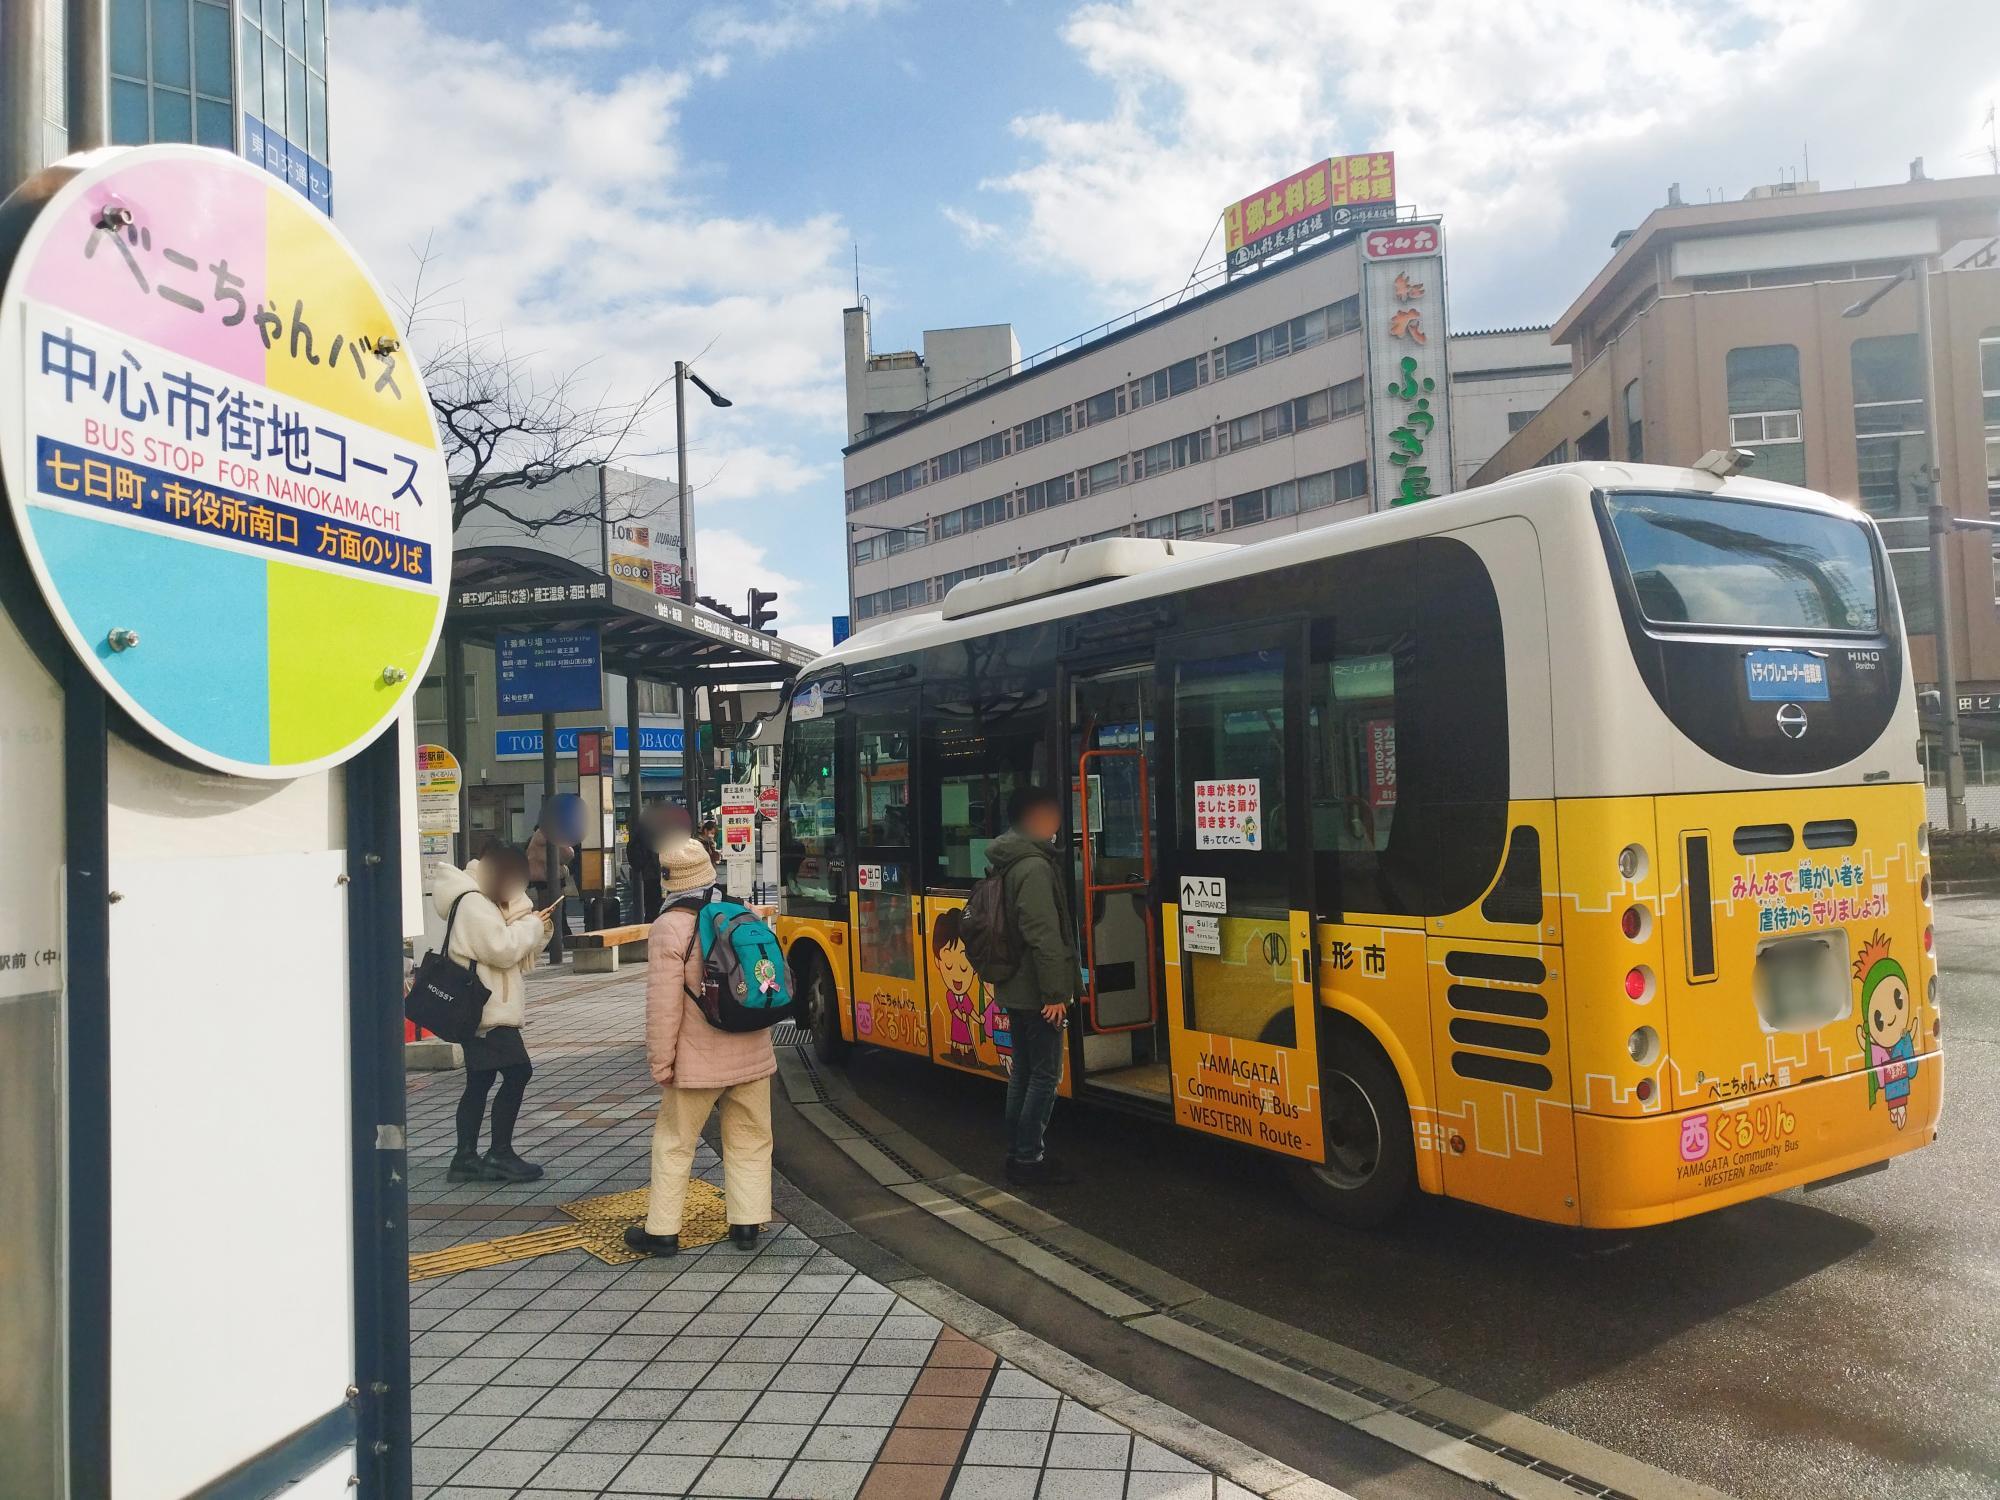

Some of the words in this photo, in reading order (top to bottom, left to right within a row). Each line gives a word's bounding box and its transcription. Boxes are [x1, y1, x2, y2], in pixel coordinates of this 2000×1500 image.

[1350, 155, 1391, 178] 郷土
[1350, 178, 1393, 200] 料理
[1246, 170, 1327, 235] 郷土料理
[1370, 230, 1434, 255] でん六
[42, 327, 423, 507] 中心市街地コース
[84, 418, 136, 457] BUS
[143, 437, 205, 475] STOP
[219, 460, 260, 493] FOR
[266, 474, 401, 531] NANOKAMACHI
[46, 449, 299, 547] 七日町・市役所南口
[316, 522, 424, 575] 方面のりば
[1847, 651, 1880, 662] HINO
[1958, 697, 2000, 710] 田ビ
[584, 750, 595, 768] 1
[1197, 784, 1256, 797] 降車が終わり
[1198, 799, 1258, 813] ましたら扉が
[1198, 816, 1241, 829] 開きます。
[868, 868, 880, 879] 出口
[1198, 881, 1221, 896] 入口
[1195, 900, 1225, 910] ENTRANCE
[0, 949, 61, 971] 駅前（中
[1331, 941, 1386, 973] 形市
[427, 983, 455, 1002] MOUSSY
[1200, 1052, 1280, 1085] YAMAGATA
[1188, 1077, 1265, 1115] Community
[1273, 1096, 1299, 1119] Bus
[1189, 1104, 1253, 1137] WESTERN
[1259, 1121, 1302, 1150] Route
[1677, 1155, 1730, 1180] YAMAGATA
[1733, 1143, 1781, 1166] Community
[1784, 1139, 1799, 1152] Bus
[1704, 1167, 1746, 1187] WESTERN
[1749, 1161, 1774, 1176] Route
